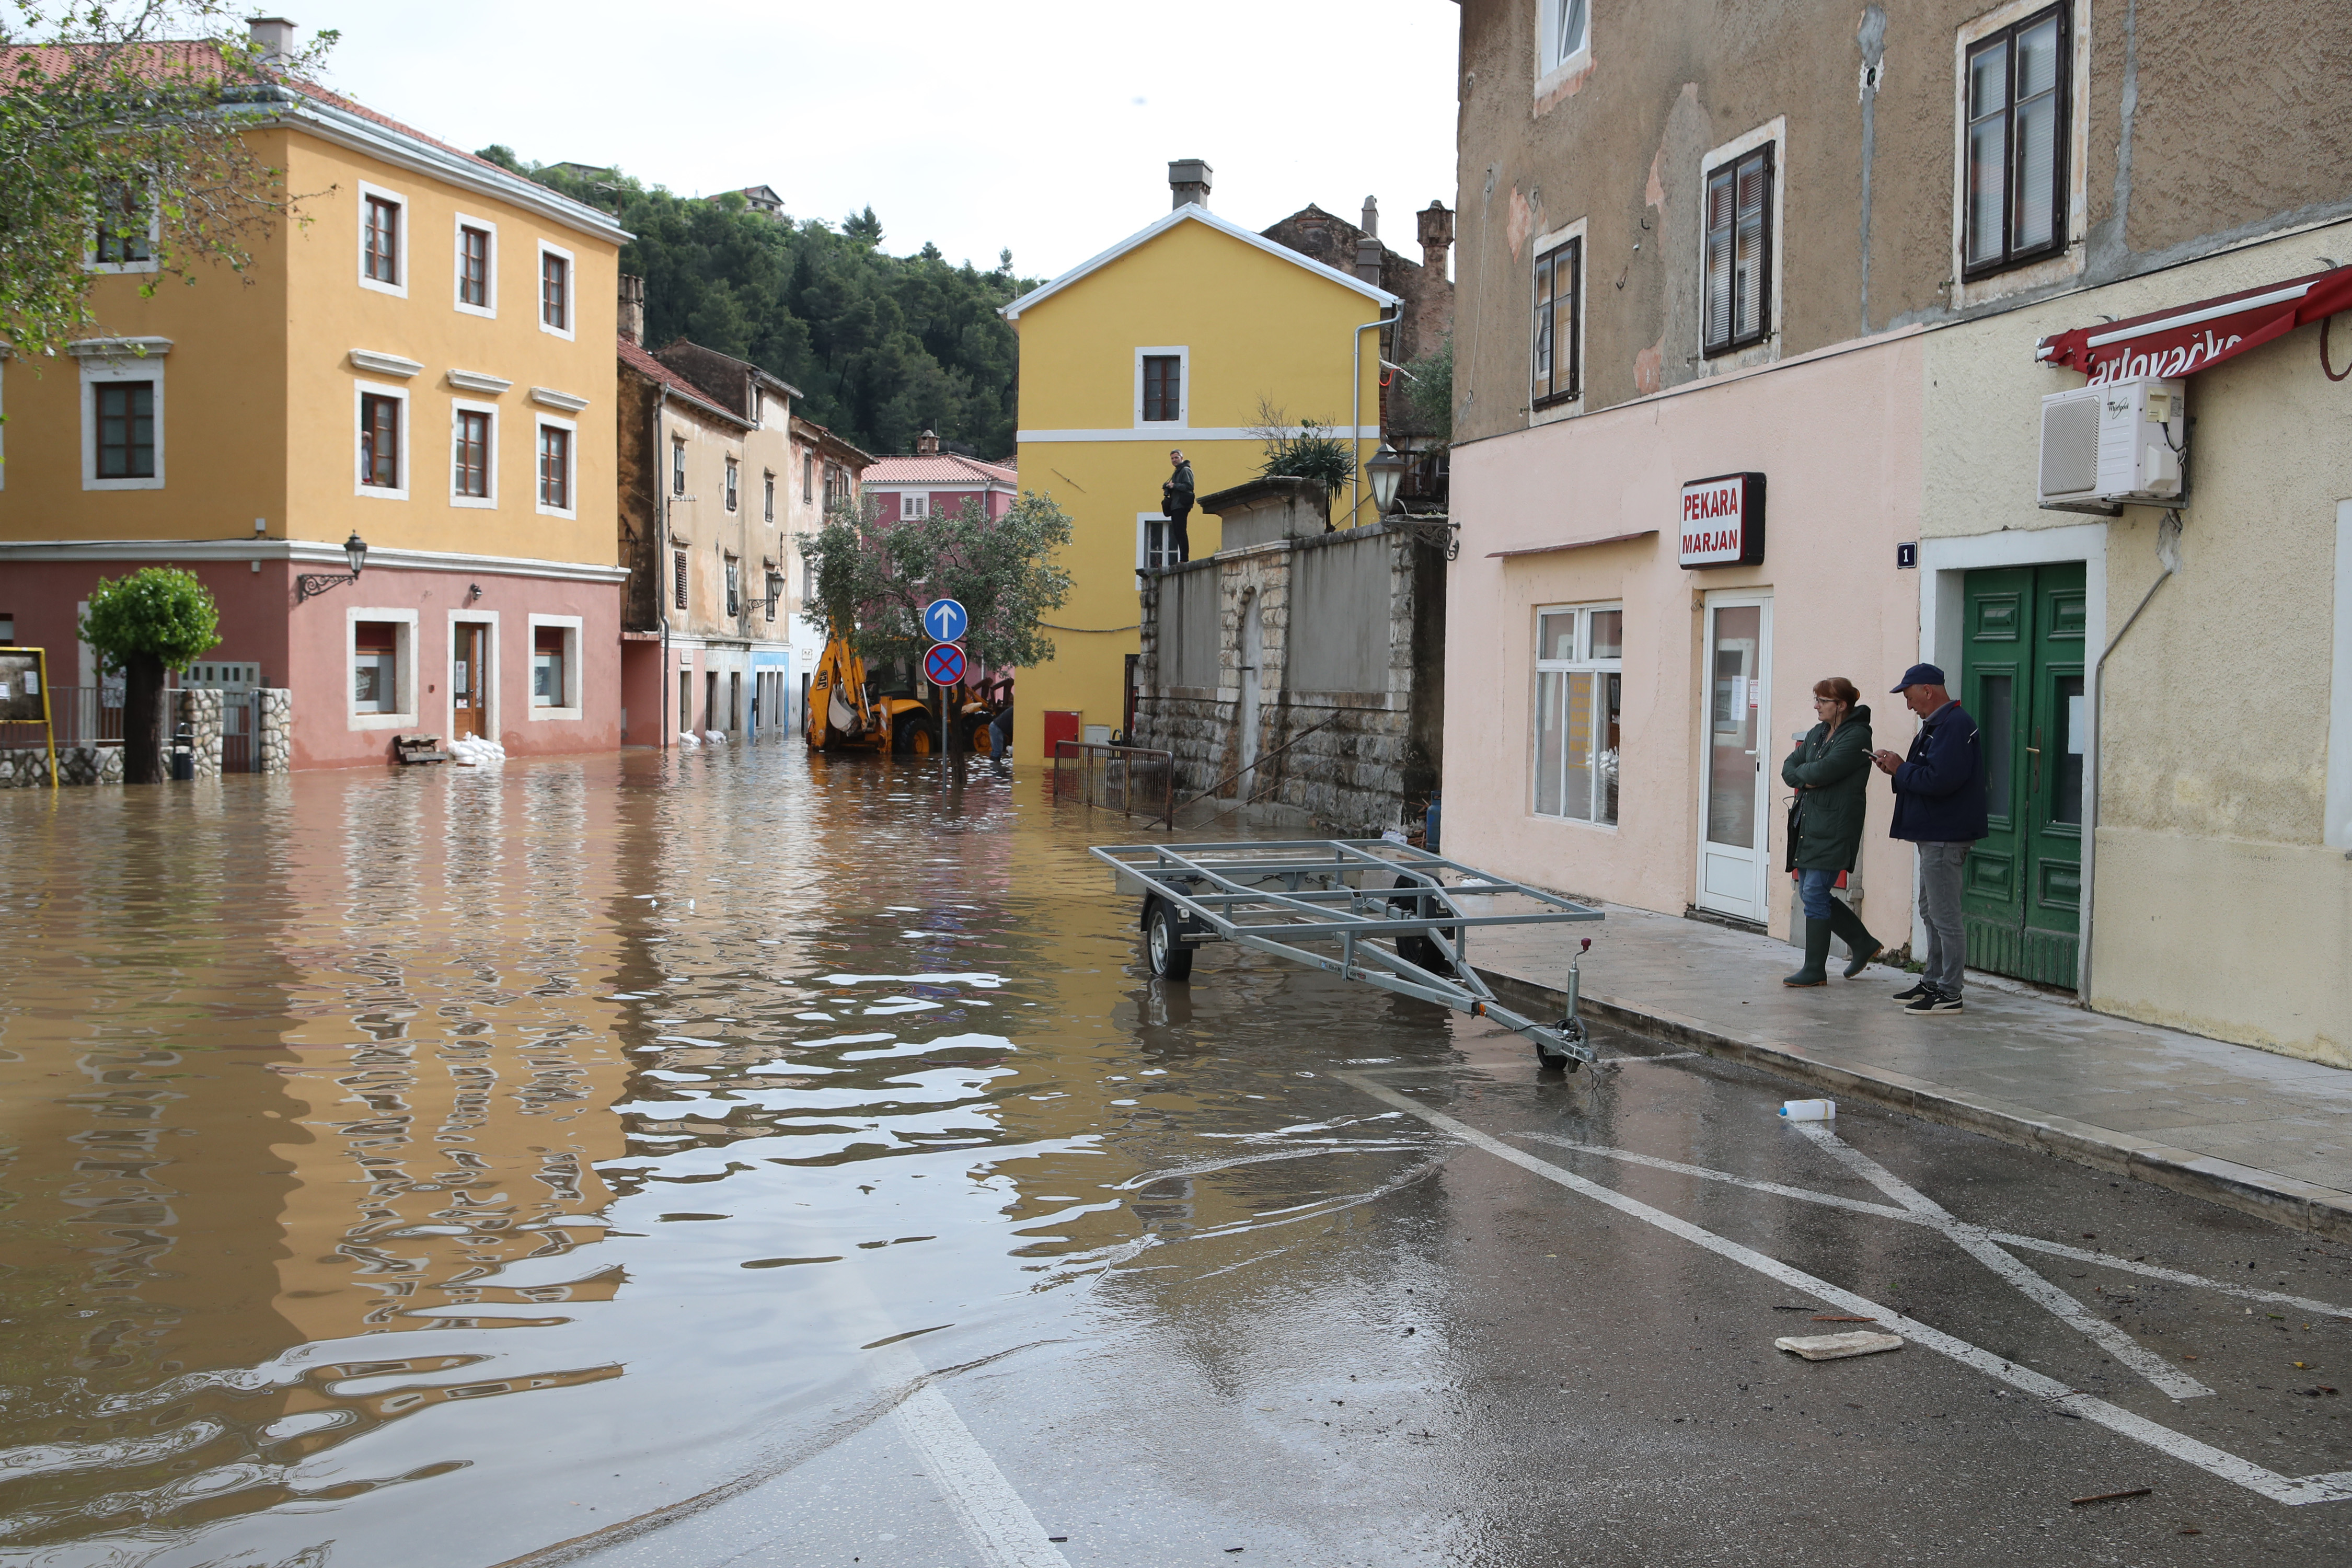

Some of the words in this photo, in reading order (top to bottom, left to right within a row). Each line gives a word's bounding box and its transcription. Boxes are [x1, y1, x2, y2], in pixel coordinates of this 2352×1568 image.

[2087, 329, 2243, 387] arlovačk
[2108, 403, 2129, 412] Whirlpool
[1684, 488, 1738, 521] PEKARA
[1682, 529, 1737, 554] MARJAN
[1903, 549, 1909, 562] 1
[817, 671, 827, 687] JCB
[1574, 683, 1590, 694] KRUH
